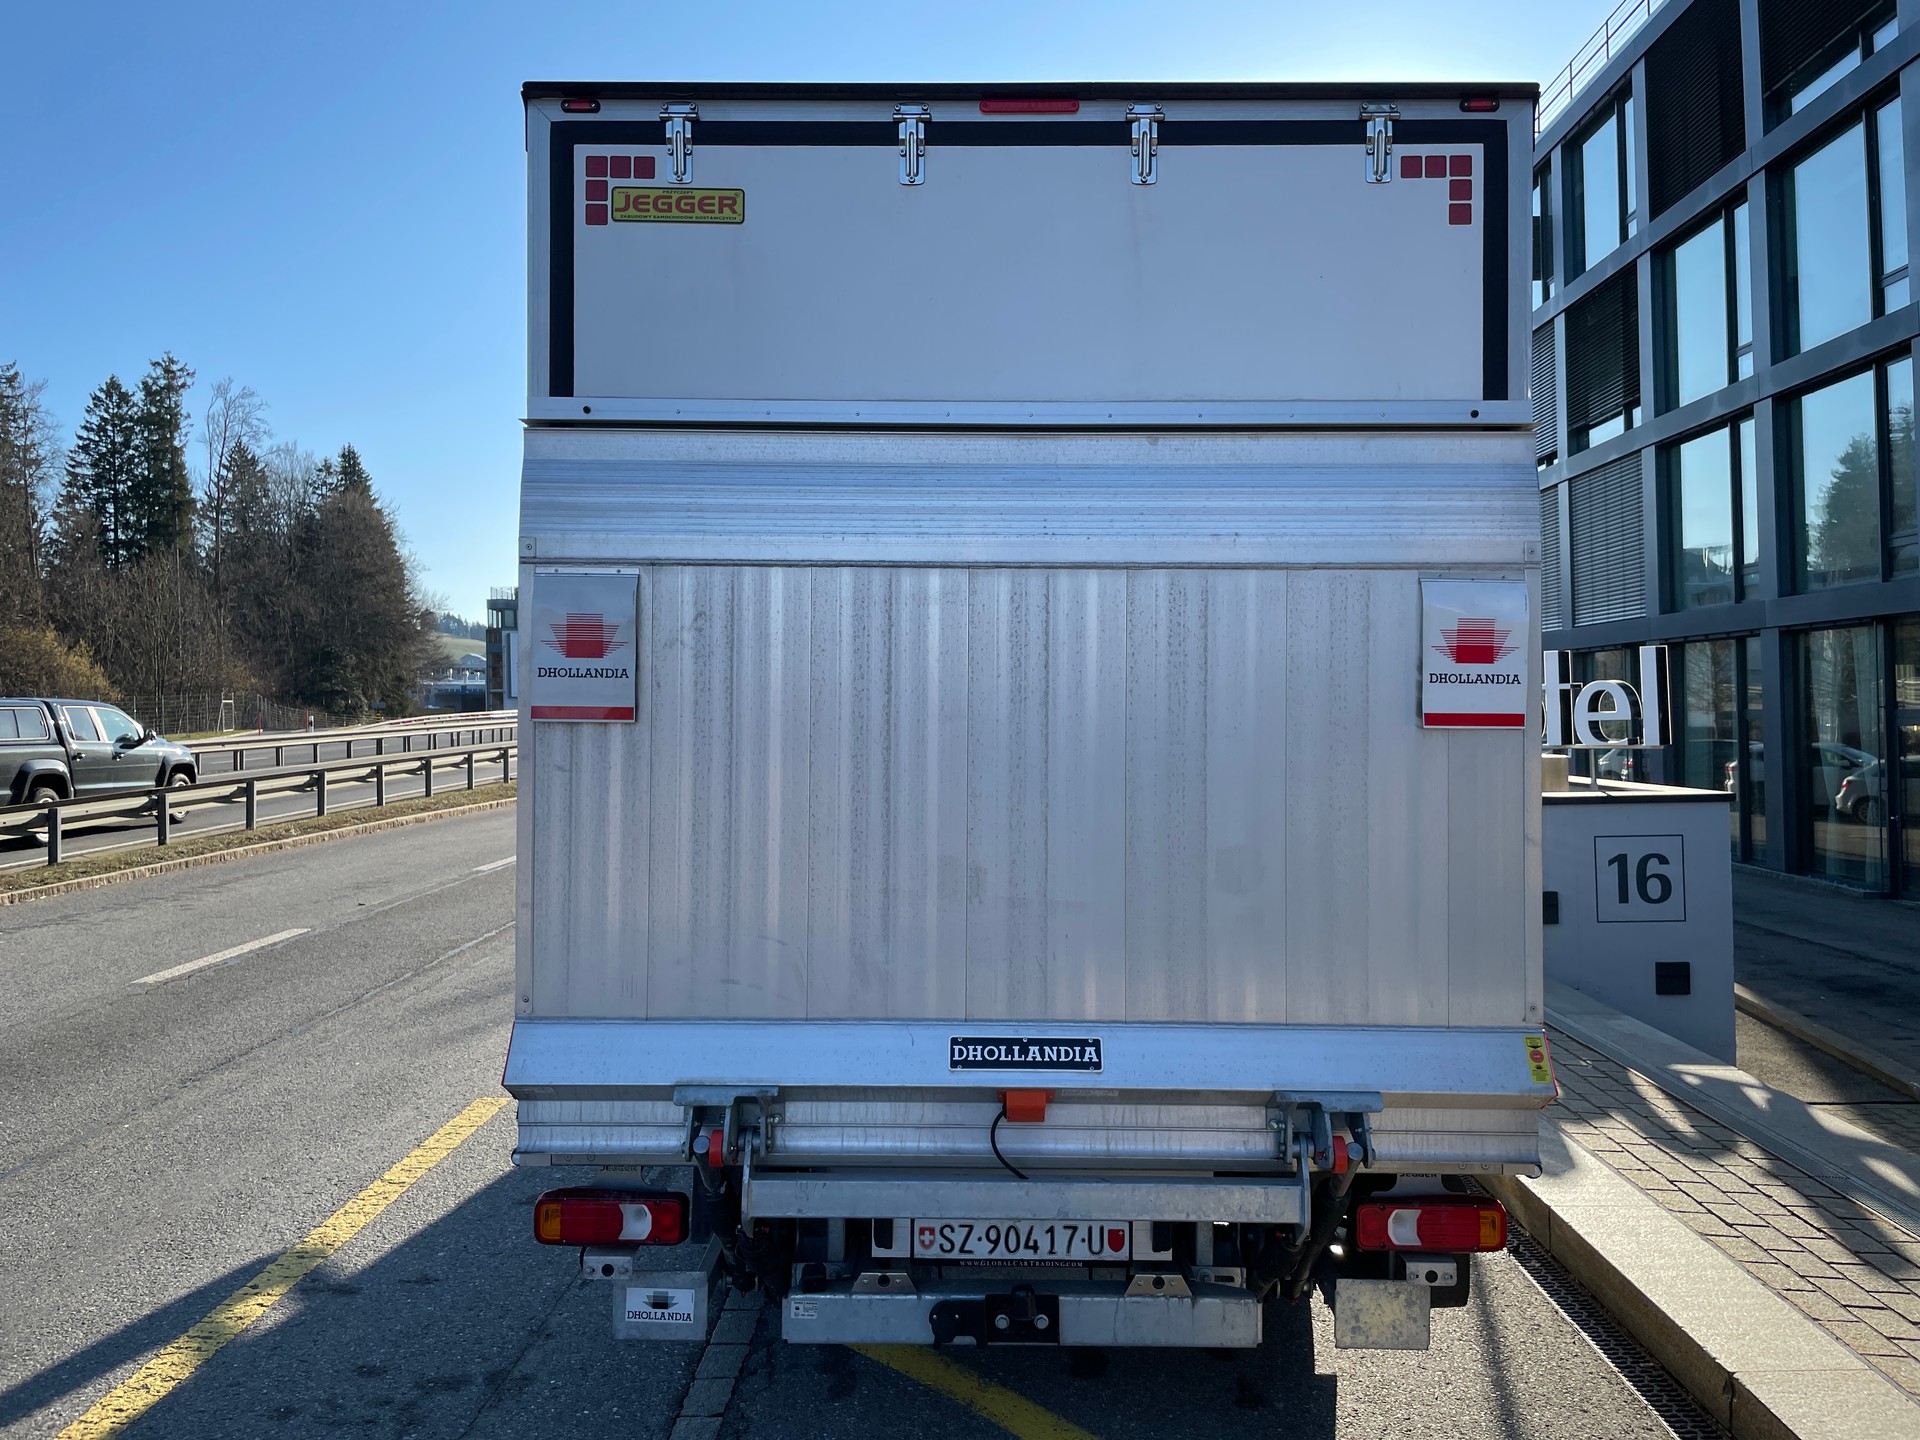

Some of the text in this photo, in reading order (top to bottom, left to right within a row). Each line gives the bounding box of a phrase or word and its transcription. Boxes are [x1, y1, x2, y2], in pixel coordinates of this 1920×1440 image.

[614, 193, 738, 215] JEGGER
[537, 667, 630, 679] DHOLLANDIA
[1429, 673, 1522, 685] DHOLLANDIA
[1541, 645, 1672, 746] tel
[1607, 853, 1673, 904] 16
[952, 1045, 1099, 1062] DHOLLANDIA
[626, 1310, 692, 1322] DHOLLANDIA
